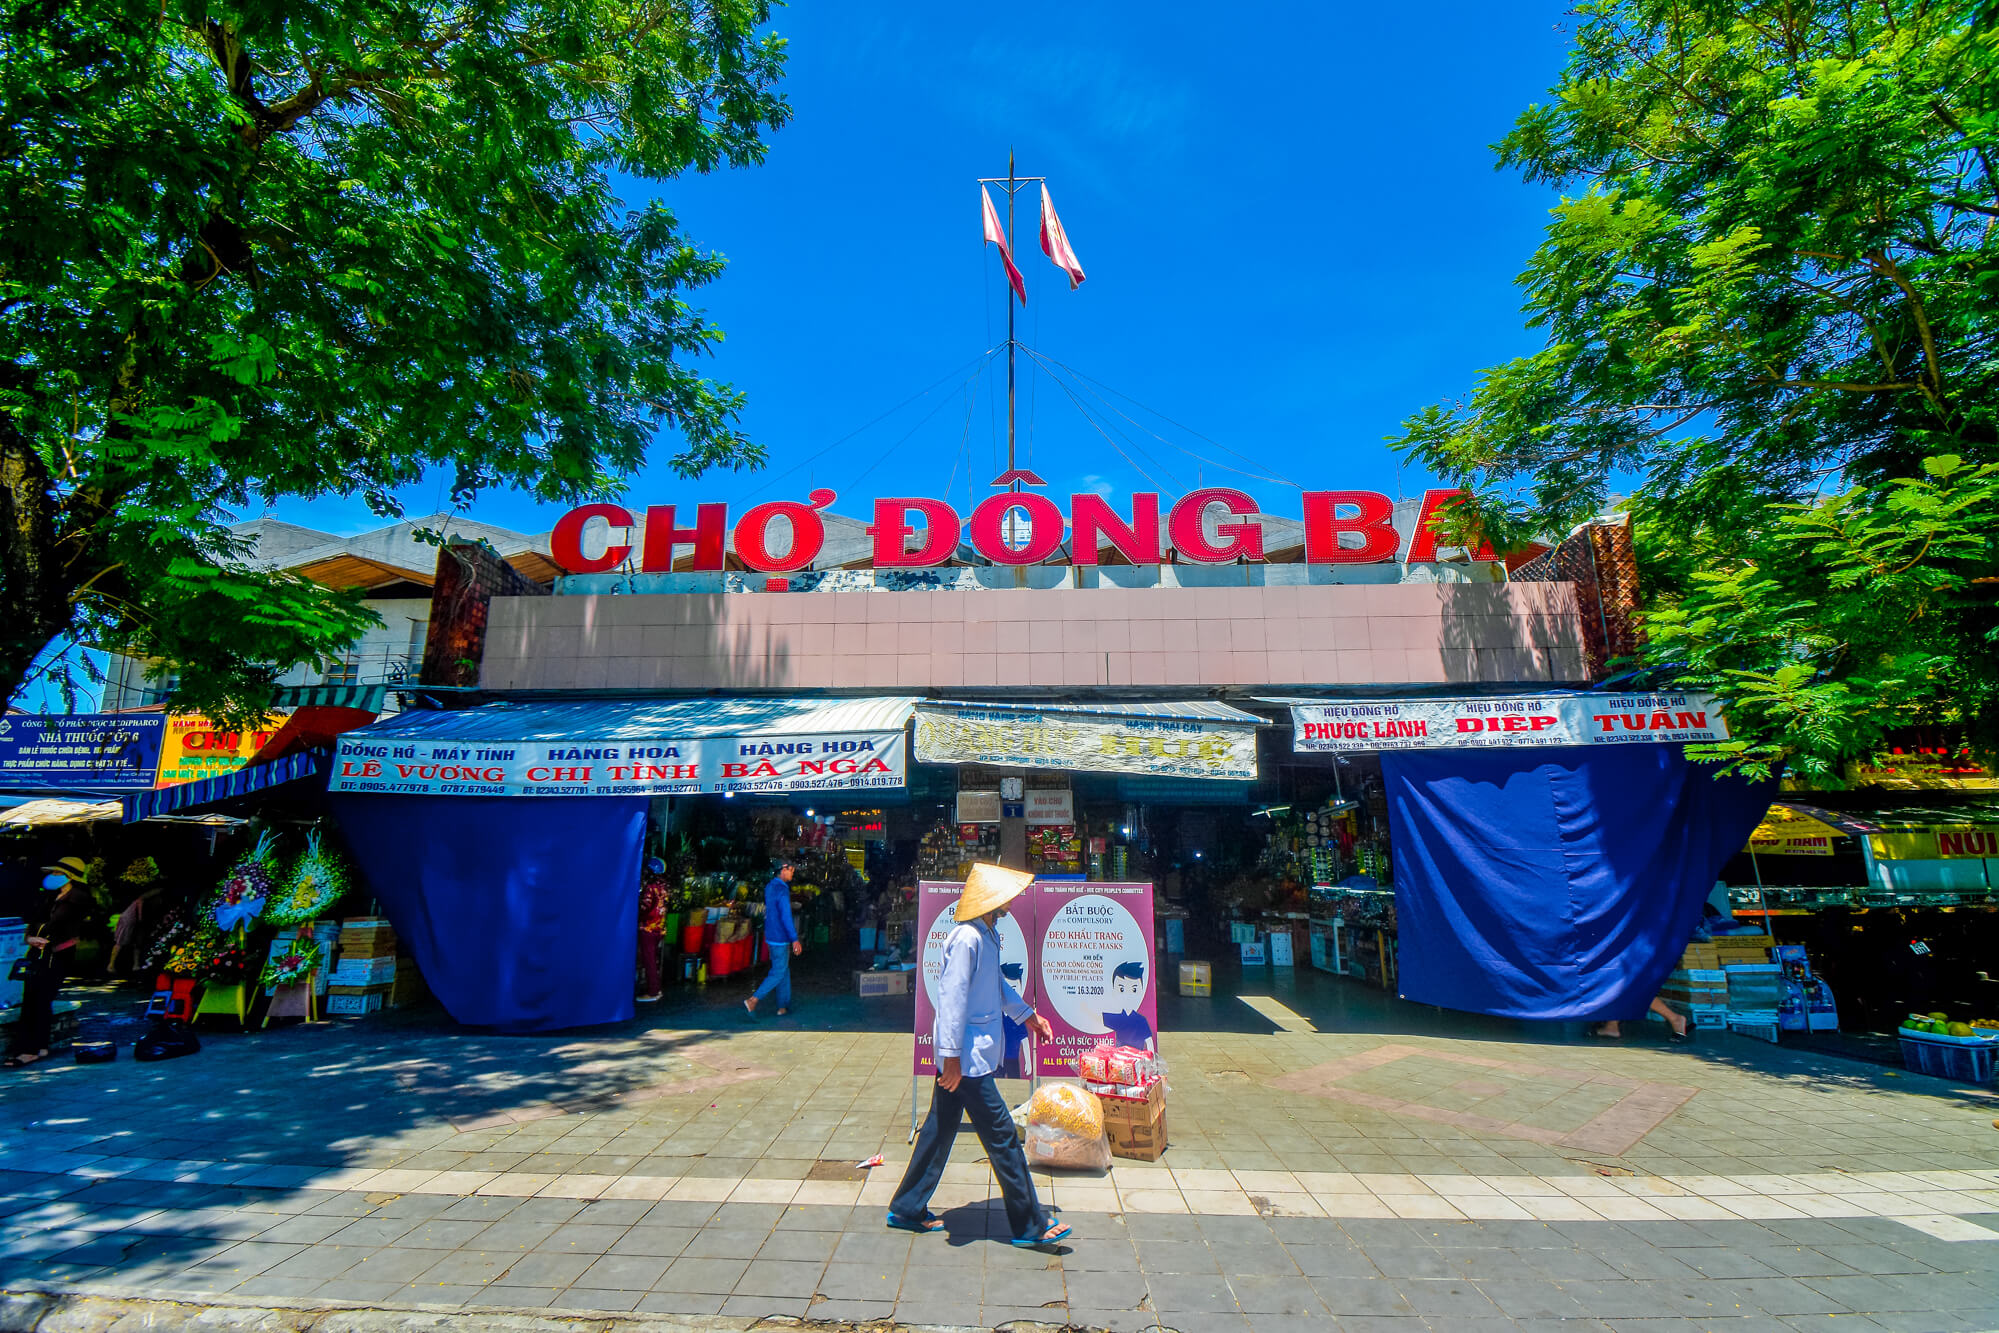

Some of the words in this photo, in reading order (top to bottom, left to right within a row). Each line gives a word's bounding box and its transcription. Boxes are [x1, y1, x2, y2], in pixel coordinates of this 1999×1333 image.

[550, 488, 837, 592] CHỢ
[865, 469, 1264, 568] ĐÔNG
[1466, 702, 1491, 714] HIỆU
[1609, 698, 1634, 710] HIỆU
[1637, 695, 1668, 708] ĐỒNG
[1670, 694, 1687, 706] HỒ
[1324, 706, 1348, 719] HIỆU
[1384, 704, 1399, 715] HỒ
[22, 719, 43, 728] CÔNG
[1455, 713, 1558, 735] DIỆP
[1593, 706, 1708, 732] TUẤN
[1303, 718, 1369, 740] PHƯỚC
[1373, 718, 1428, 738] LÀNH
[37, 730, 62, 743] NHÀ
[132, 731, 140, 742] 6
[182, 731, 239, 754] CHỊ
[341, 742, 387, 757] ĐỒNG
[393, 744, 416, 759] HỒ
[431, 746, 472, 760] MÁY
[476, 747, 516, 761] TÍNH
[548, 746, 619, 760] HÀNG
[629, 747, 681, 760] HOA
[739, 741, 813, 756] HÀNG
[822, 740, 875, 752] HOA
[340, 759, 383, 778] LÊ
[395, 763, 507, 782] VƯƠNG
[526, 766, 594, 785] CHỊ
[606, 761, 700, 781] TÌNH
[720, 758, 781, 778] BÀ
[797, 757, 893, 775] NGA
[340, 781, 358, 791] ĐT:
[359, 782, 429, 792] 0905.477978
[714, 783, 727, 792] ĐT:
[728, 781, 783, 792] 02343.527476
[849, 776, 903, 788] 0914.019.778
[1087, 904, 1114, 917] BUỘC
[1067, 917, 1114, 925] COMPULSORY
[931, 931, 948, 940] ĐEO
[1049, 931, 1066, 939] ĐEO
[1094, 931, 1123, 940] TRANG
[1079, 942, 1097, 950] FACE
[1068, 960, 1085, 968] CÔNG
[1086, 961, 1103, 969] CỘNG
[1077, 986, 1104, 995] 16.3.2020
[918, 1033, 932, 1045] TẤT
[1055, 1035, 1066, 1045] CẢ
[1067, 1035, 1076, 1045] VÌ
[1077, 1035, 1093, 1045] SỨC
[1060, 1046, 1075, 1056] CỦA
